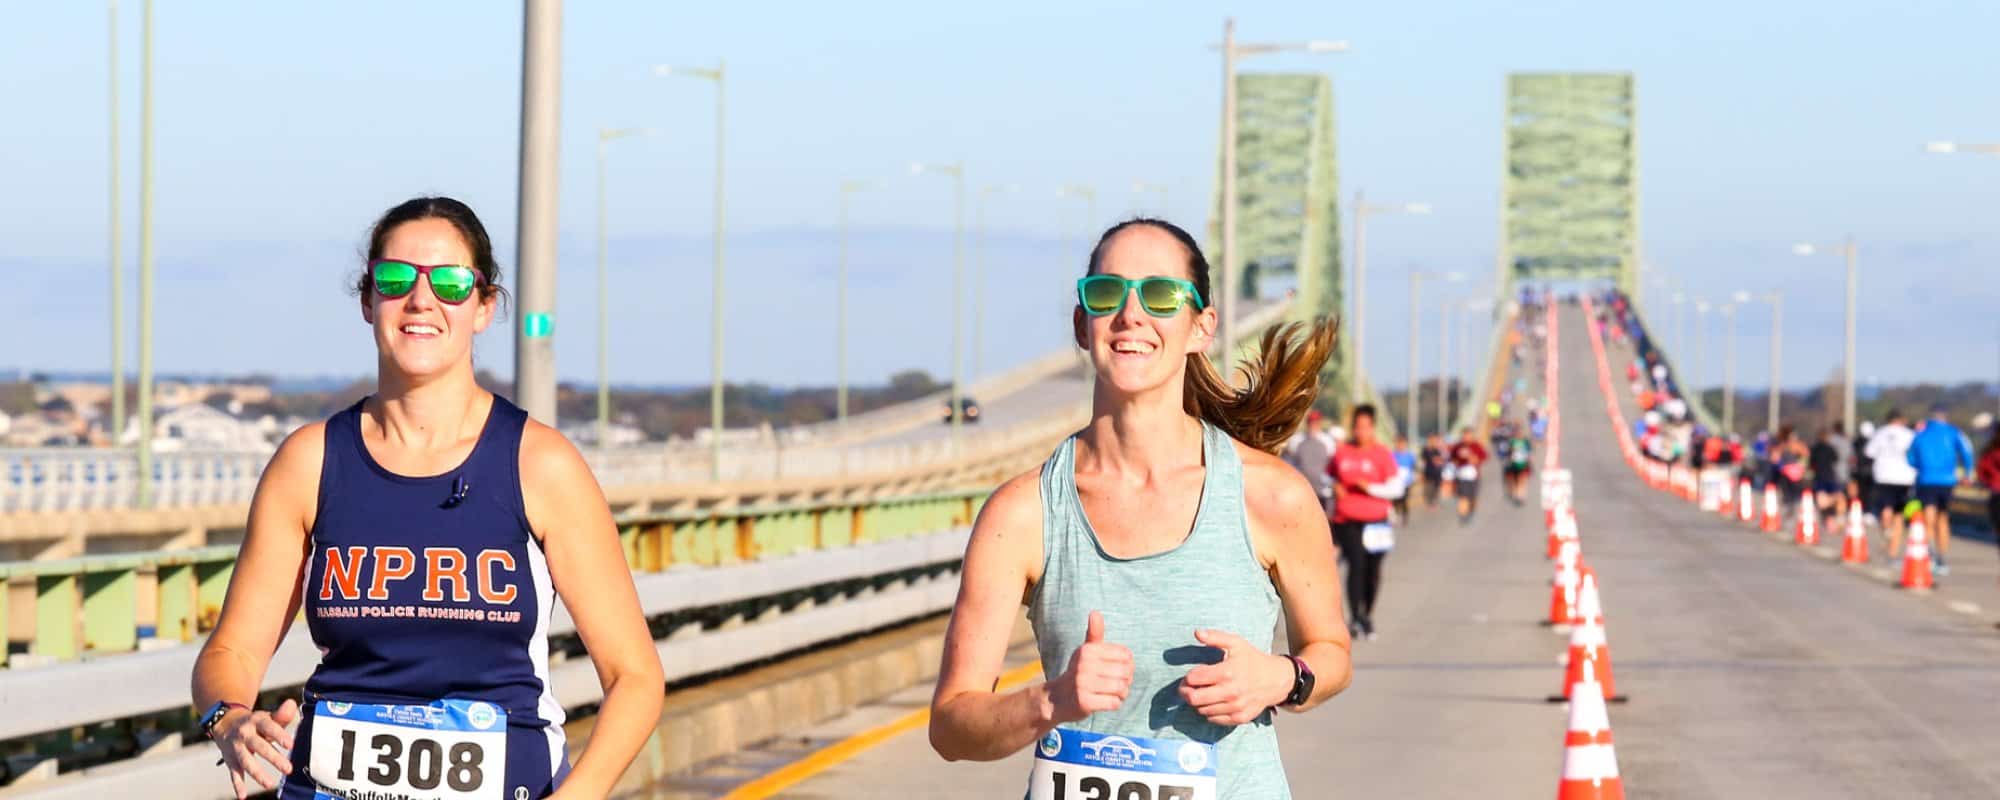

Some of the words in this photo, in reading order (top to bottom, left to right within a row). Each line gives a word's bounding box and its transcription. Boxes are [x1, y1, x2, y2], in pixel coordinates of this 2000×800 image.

[319, 546, 518, 605] NPRC
[317, 606, 358, 618] NASSAU
[361, 605, 415, 618] POLICE
[418, 606, 485, 621] RUNNING
[487, 611, 521, 623] CLUB
[337, 729, 484, 792] 1308
